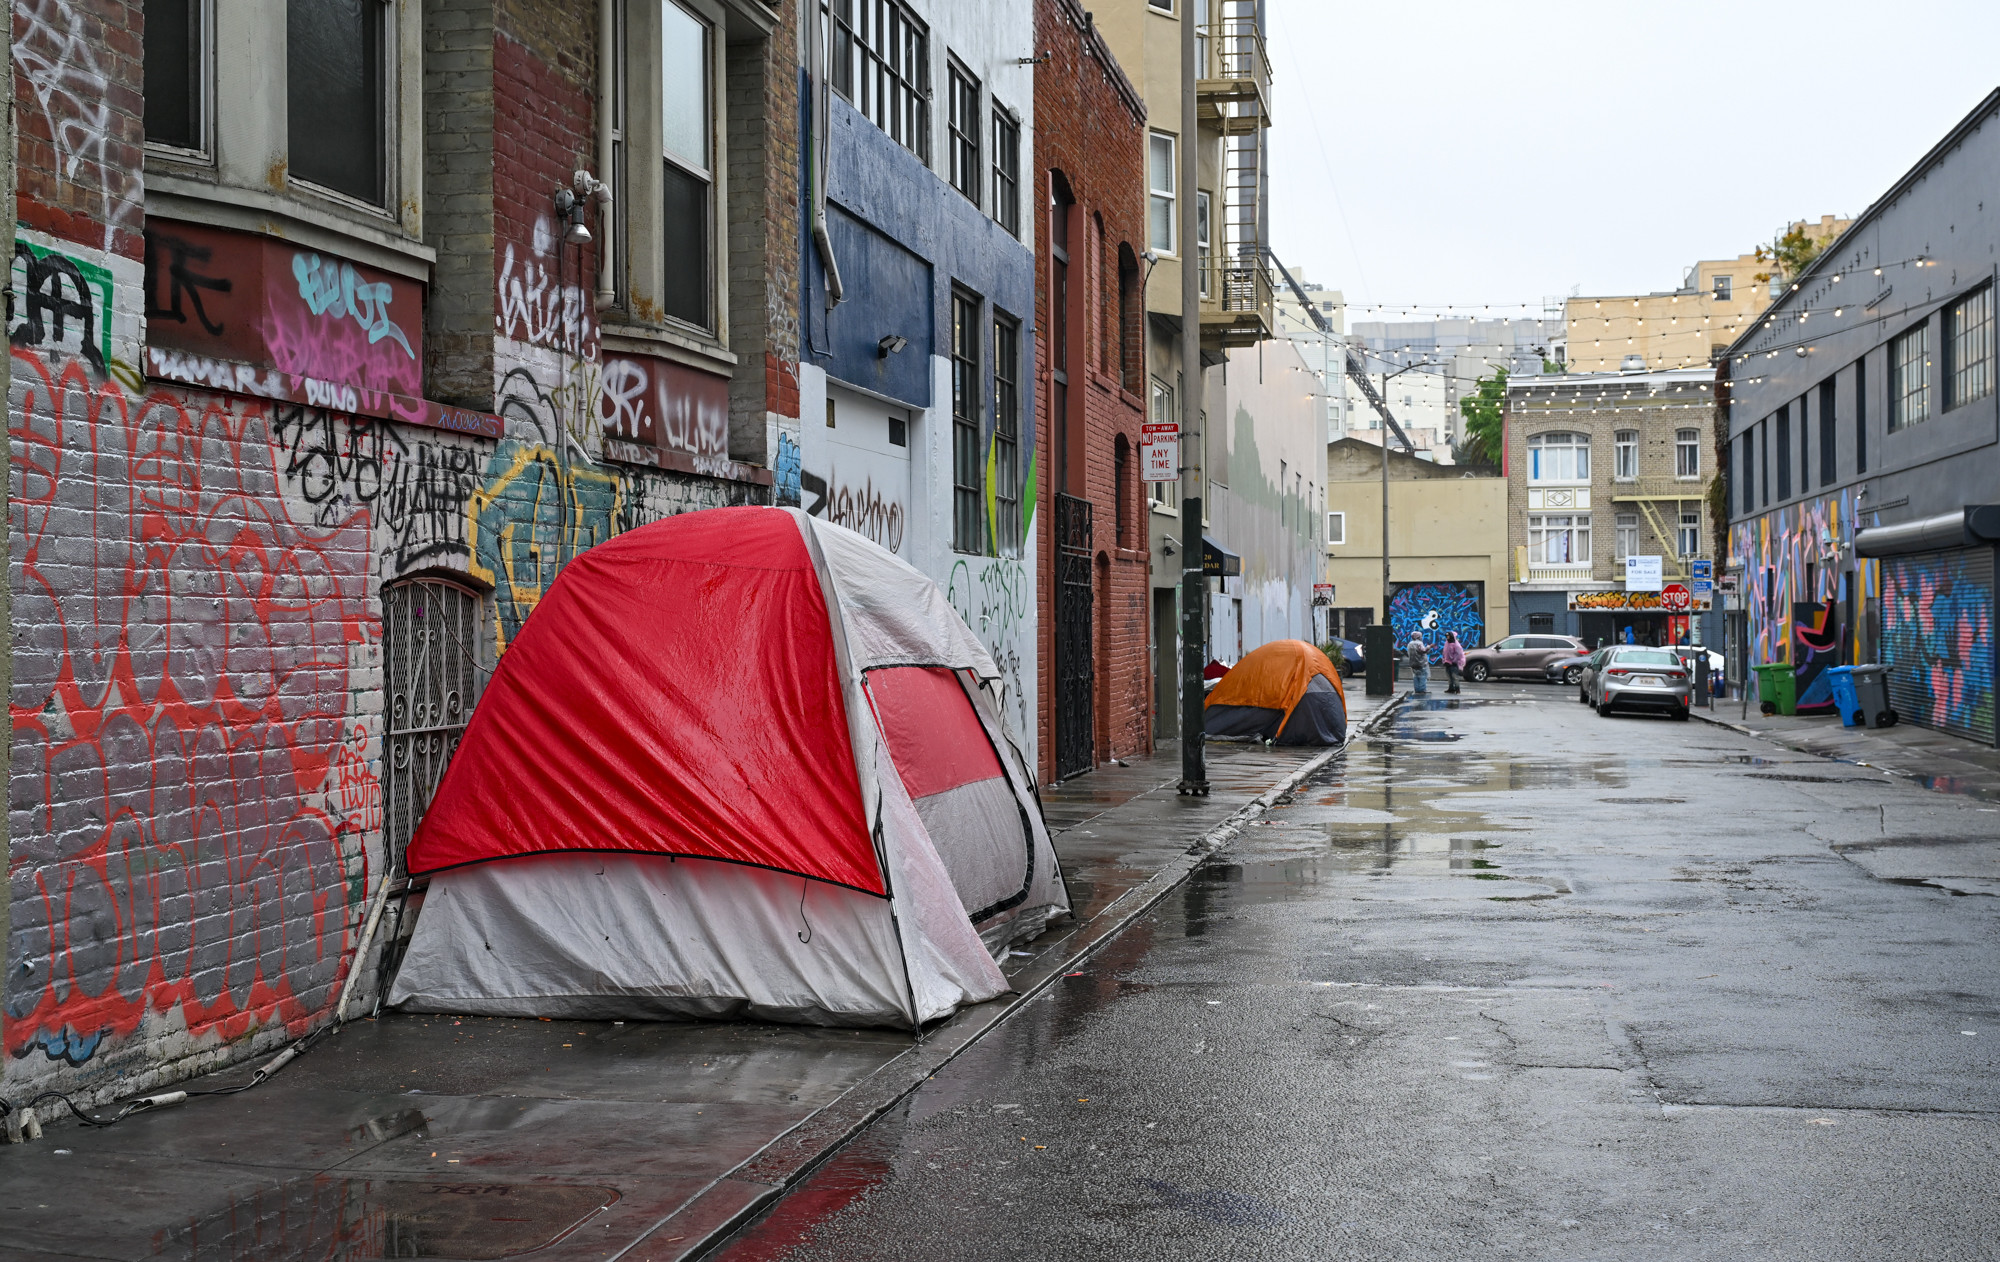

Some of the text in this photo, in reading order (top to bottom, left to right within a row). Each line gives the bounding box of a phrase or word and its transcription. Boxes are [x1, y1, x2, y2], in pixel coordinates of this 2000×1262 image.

[1142, 432, 1177, 444] NO PARKING
[1152, 449, 1168, 458] ANY
[1151, 460, 1170, 469] TIME
[1663, 592, 1688, 604] STOP
